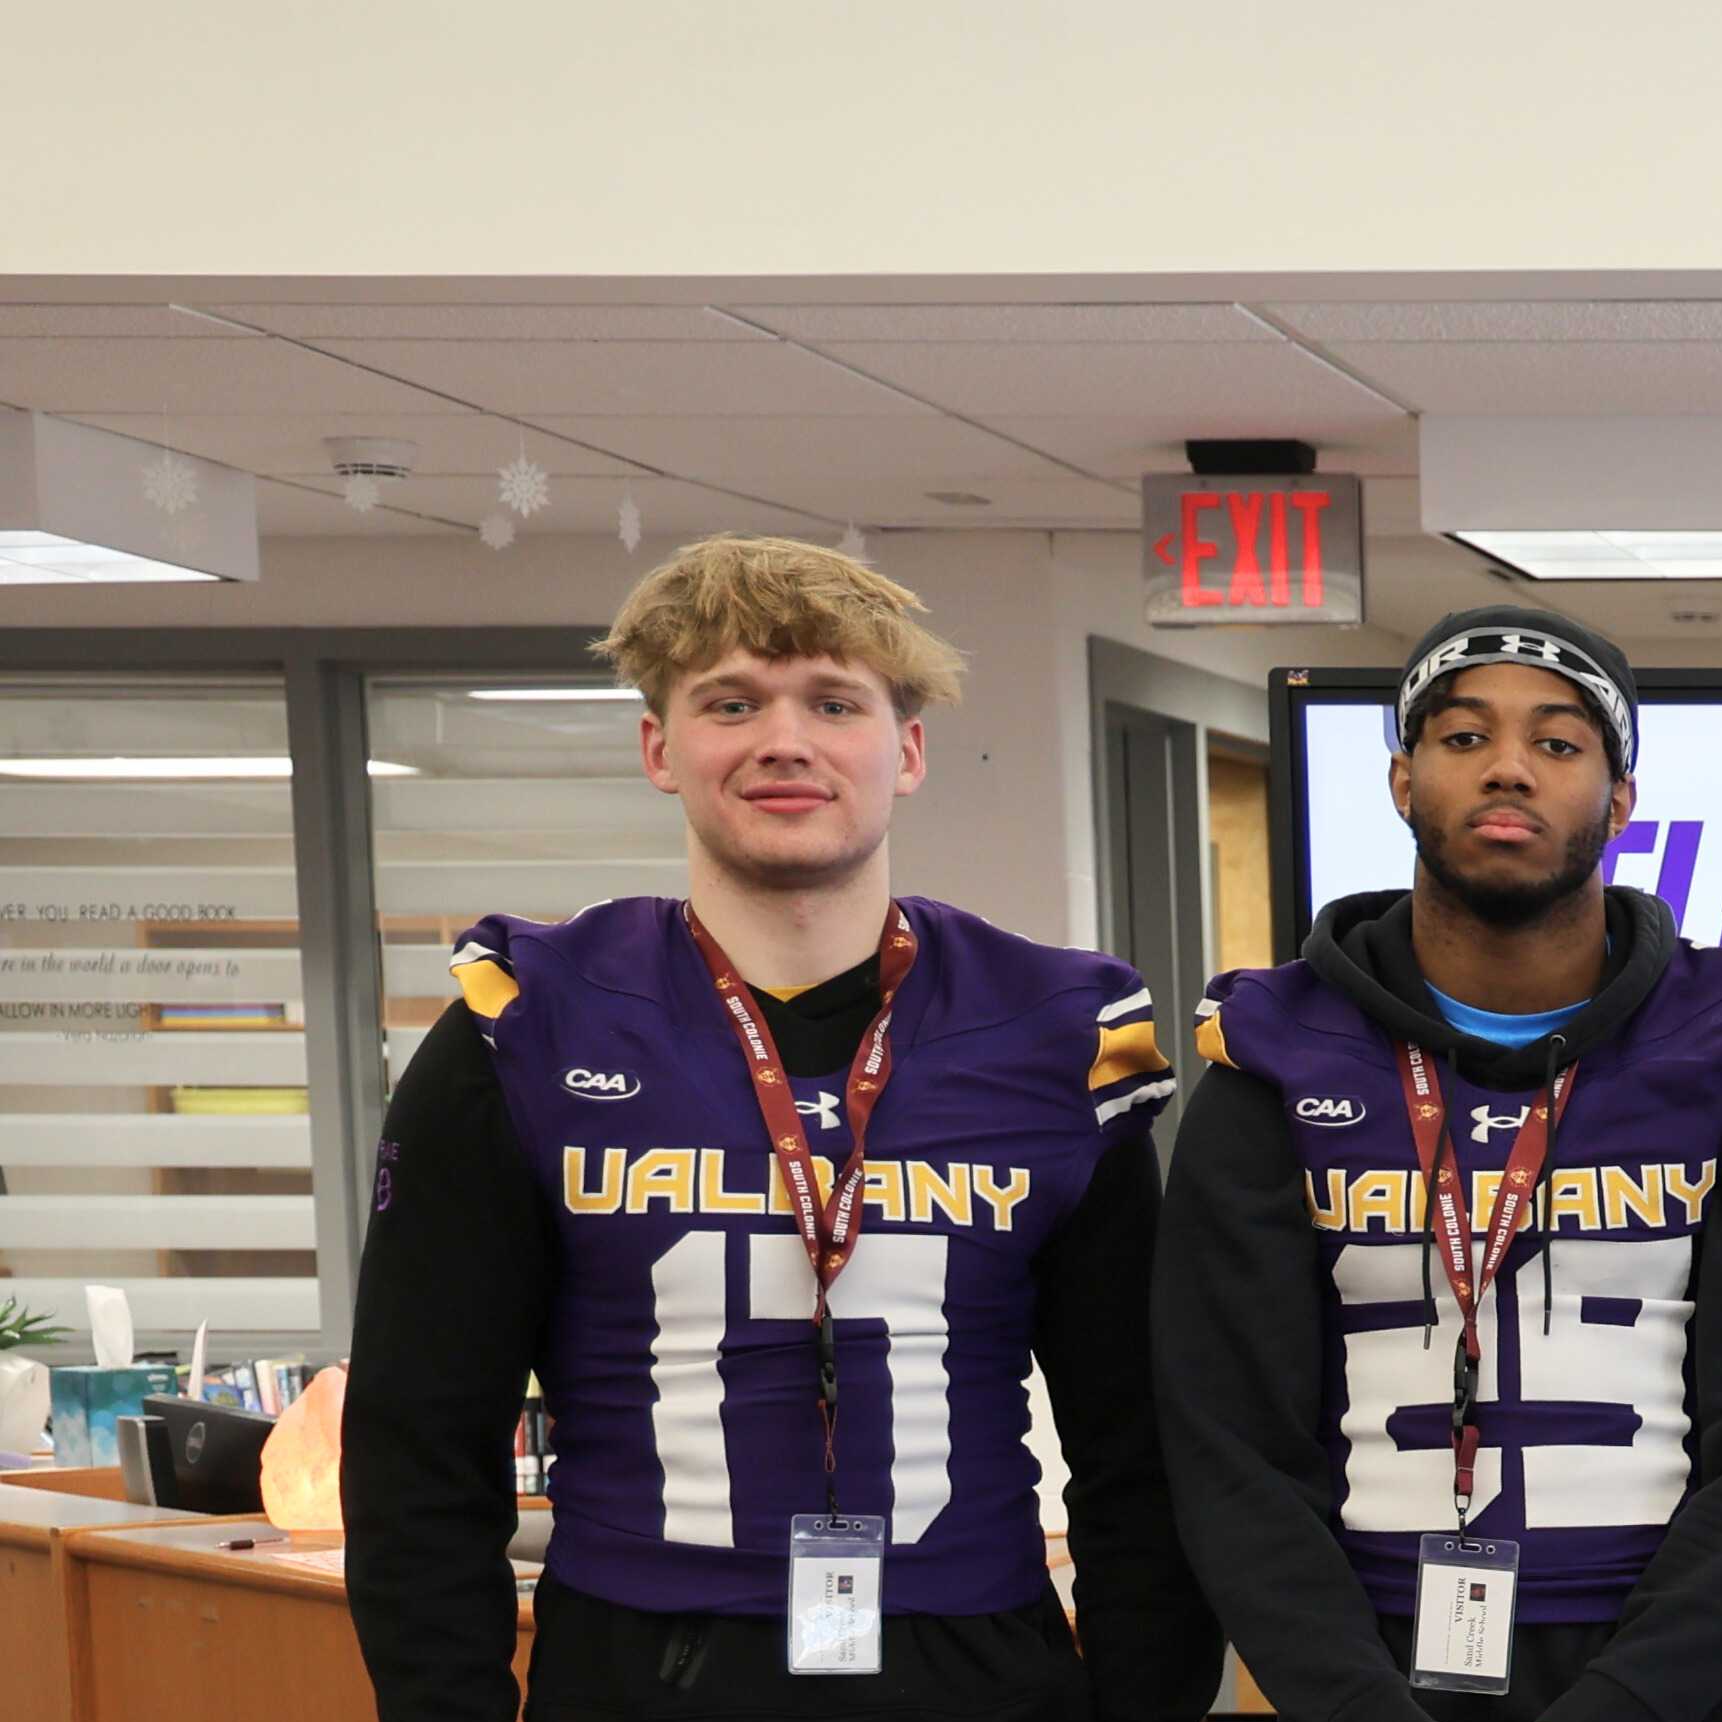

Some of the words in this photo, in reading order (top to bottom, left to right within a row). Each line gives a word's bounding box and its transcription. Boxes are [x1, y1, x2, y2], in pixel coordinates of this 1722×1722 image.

[1180, 492, 1331, 608] EXIT
[36, 904, 68, 922] YOU
[80, 903, 120, 921] READ
[143, 903, 192, 921] GOOD
[197, 904, 236, 920] BOOK
[41, 952, 62, 974] the
[69, 952, 115, 975] world
[136, 952, 171, 975] door
[176, 960, 220, 981] opens
[225, 959, 241, 976] to
[49, 1002, 64, 1018] IN
[68, 1002, 112, 1018] MORE
[726, 996, 752, 1027] SOUTH
[740, 1022, 769, 1061] COLONIE
[565, 1069, 628, 1093] CAA
[1411, 1064, 1431, 1096] SOUTH
[1296, 1098, 1354, 1118] CAA
[789, 1161, 806, 1198] SOUTH
[799, 1194, 817, 1241] COLONIE
[840, 1167, 863, 1213] COLONIE
[833, 1207, 851, 1244] SOUTH
[1439, 1192, 1460, 1237] COLONIE
[1498, 1193, 1520, 1228] SOUTH
[1450, 1233, 1466, 1272] SOUTH
[1486, 1225, 1509, 1270] COLONIE
[650, 1230, 953, 1549] 17
[1455, 1577, 1467, 1624] VISITOR
